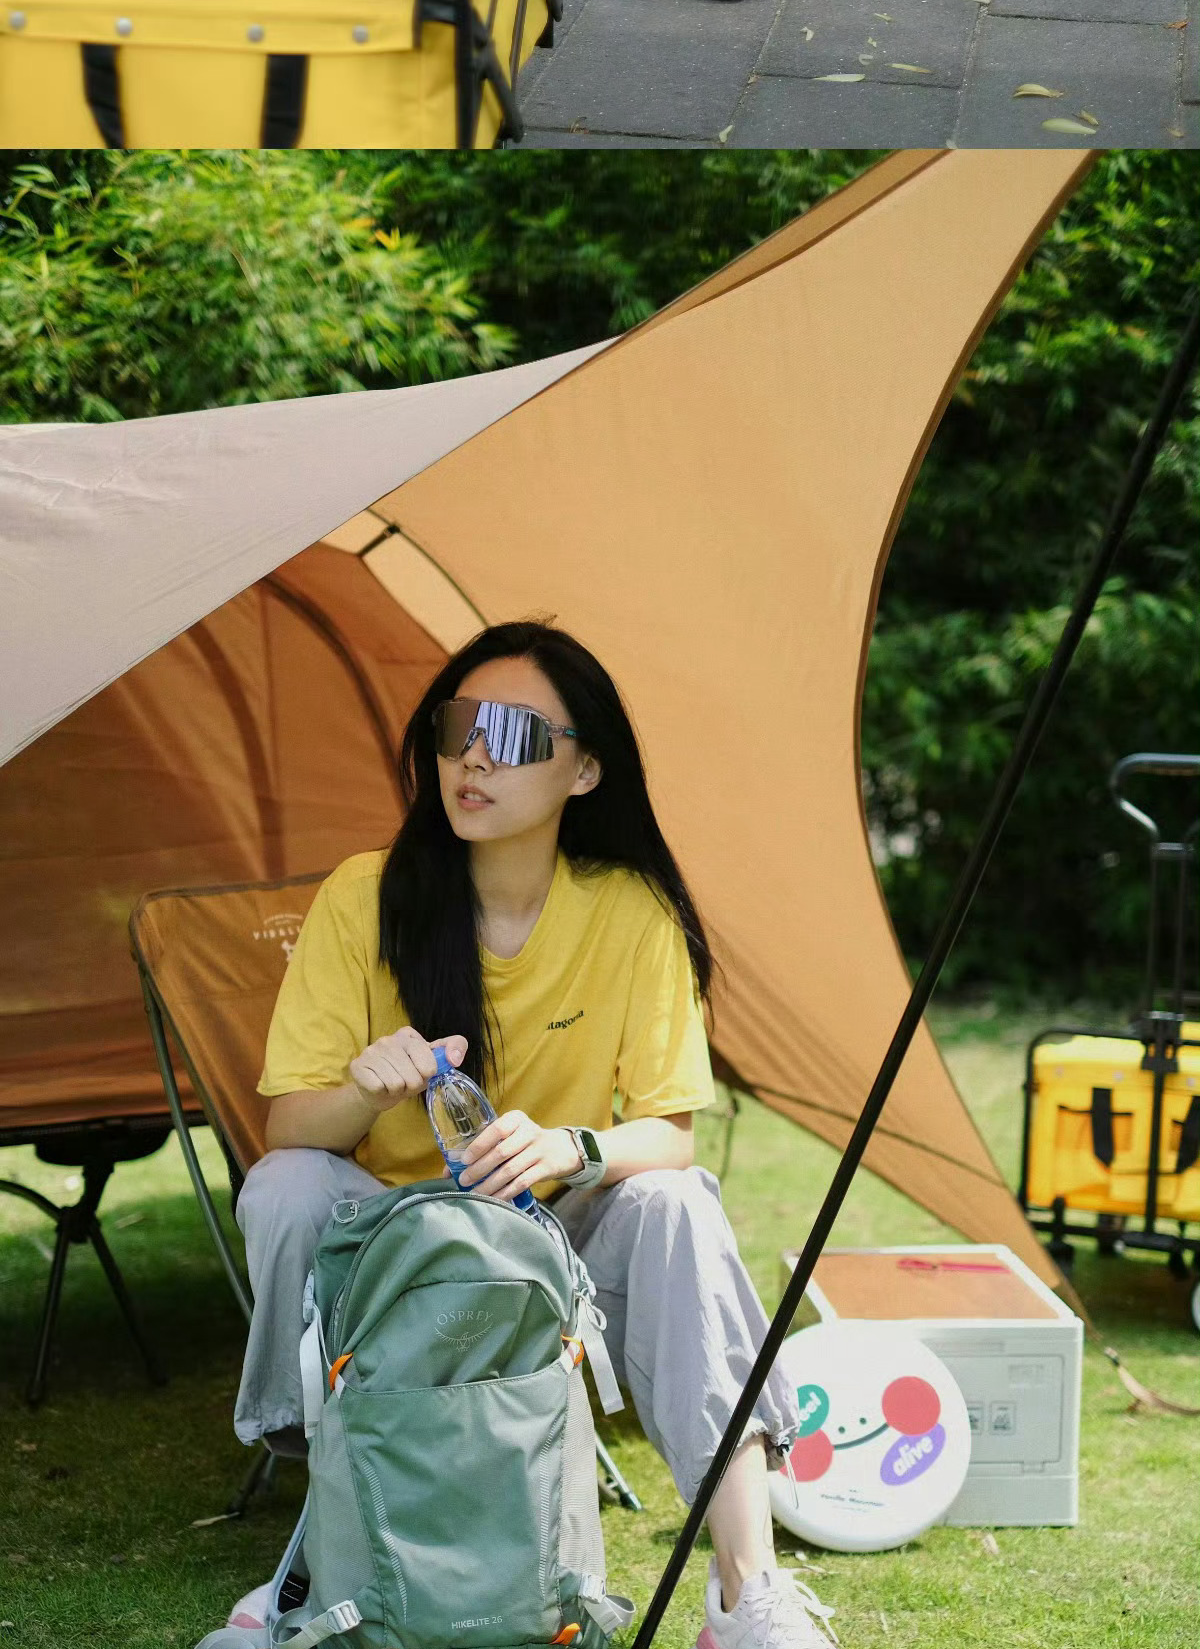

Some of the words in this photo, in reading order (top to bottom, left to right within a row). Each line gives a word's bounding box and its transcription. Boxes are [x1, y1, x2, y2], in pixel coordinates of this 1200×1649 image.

[436, 1310, 493, 1325] OSPREY
[893, 1435, 934, 1477] alive
[451, 1617, 490, 1630] HIKELITE
[492, 1615, 503, 1624] 26
